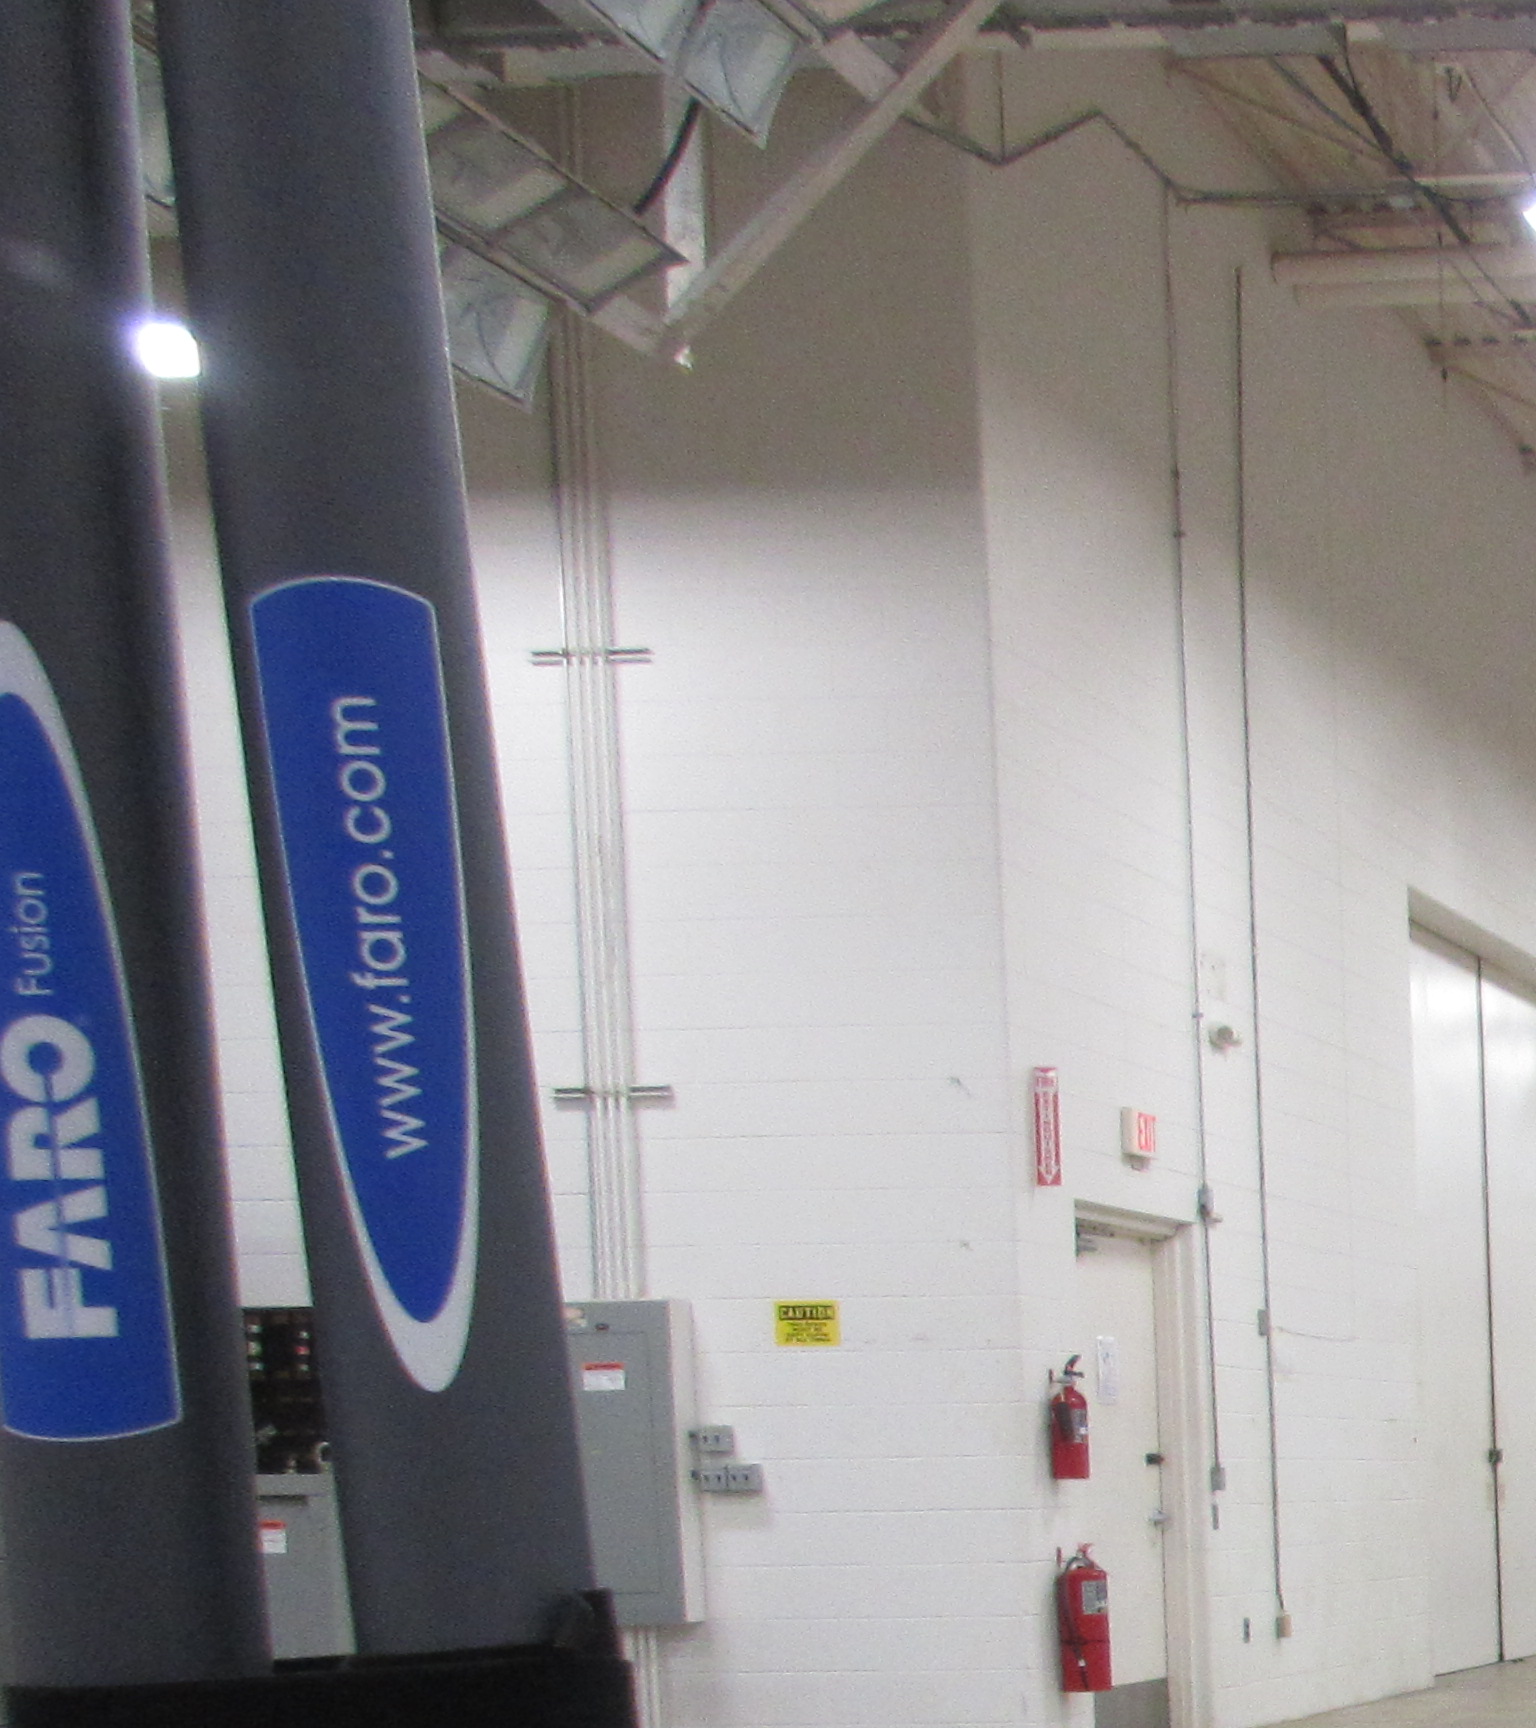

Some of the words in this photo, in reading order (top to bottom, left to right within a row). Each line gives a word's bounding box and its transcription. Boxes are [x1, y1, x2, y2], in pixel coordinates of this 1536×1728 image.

[8, 872, 53, 997] Fusion
[330, 694, 429, 1160] www.faro.com
[1, 1013, 119, 1340] FARO
